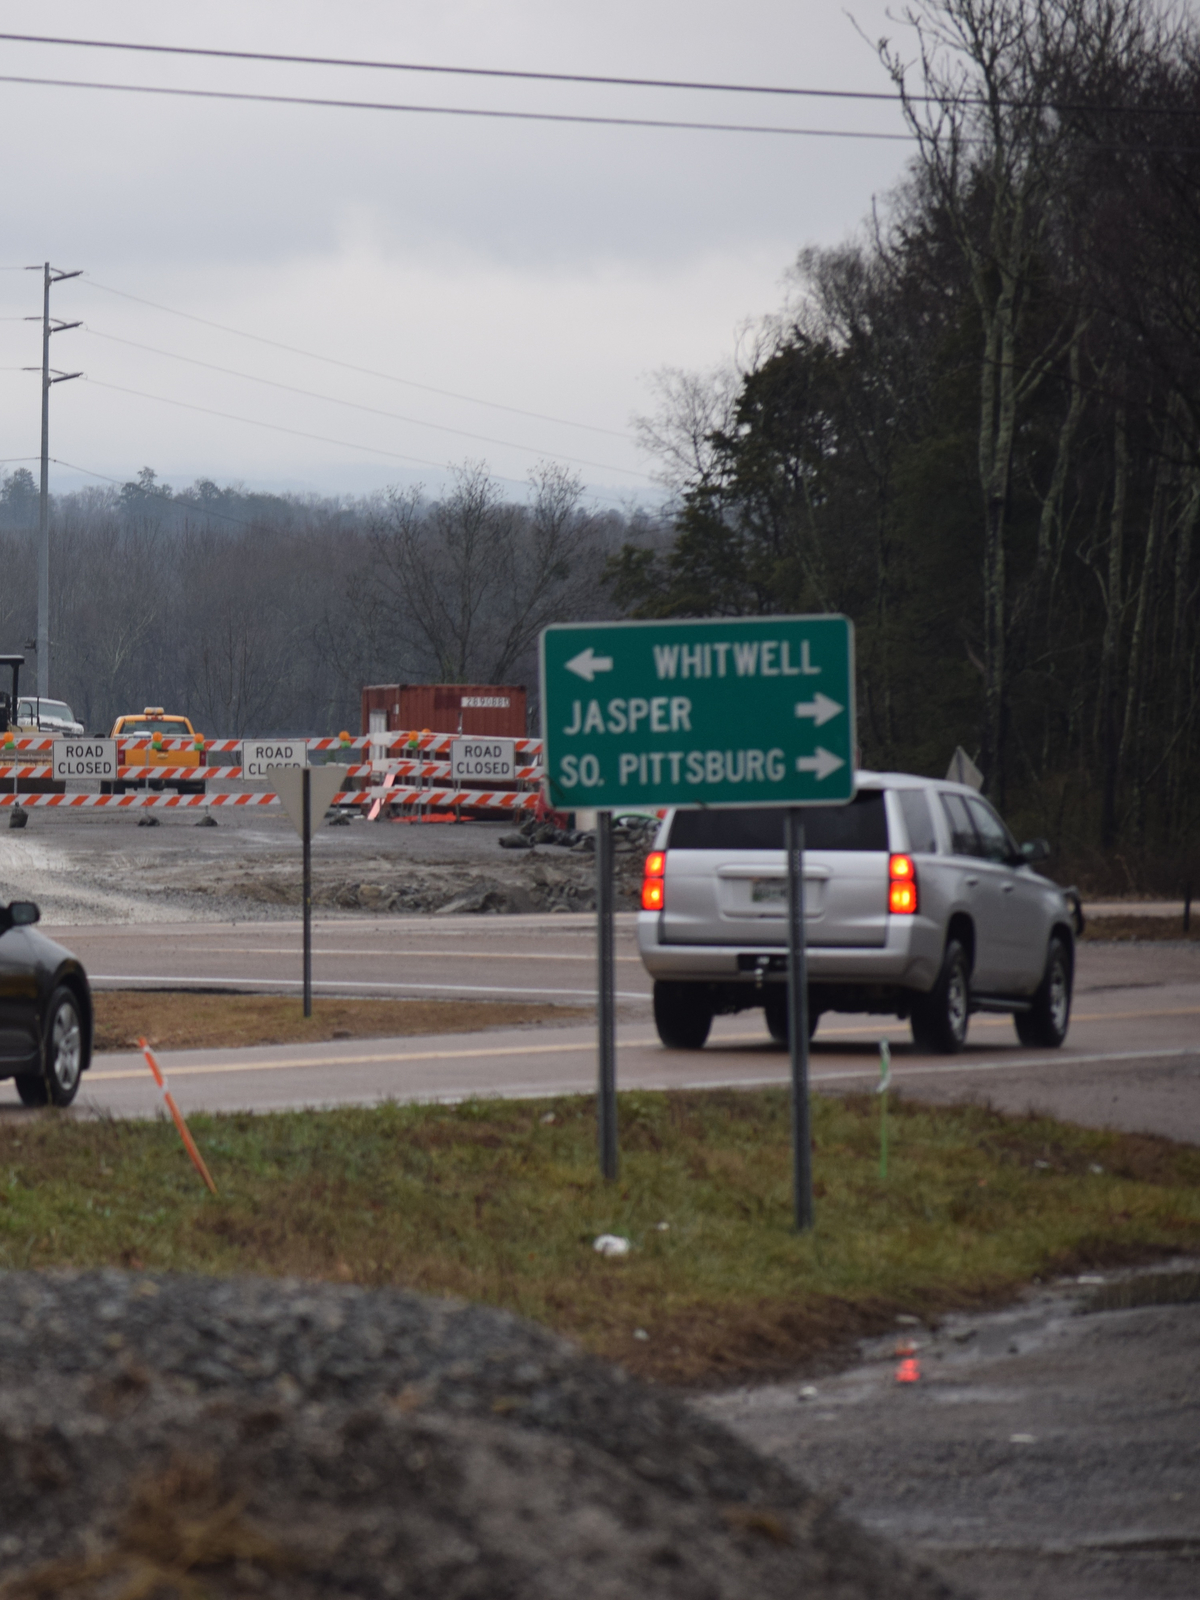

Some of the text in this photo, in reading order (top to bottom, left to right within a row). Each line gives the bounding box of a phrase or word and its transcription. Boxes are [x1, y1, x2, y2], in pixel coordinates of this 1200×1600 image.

[653, 640, 821, 679] WHITWELL
[563, 697, 691, 735] JASPER
[66, 745, 103, 757] ROAD
[256, 747, 293, 759] ROAD
[464, 745, 502, 758] ROAD
[58, 761, 112, 774] CLOSED
[457, 762, 510, 774] CLOSED
[560, 748, 785, 787] SO. PITTSBURG
